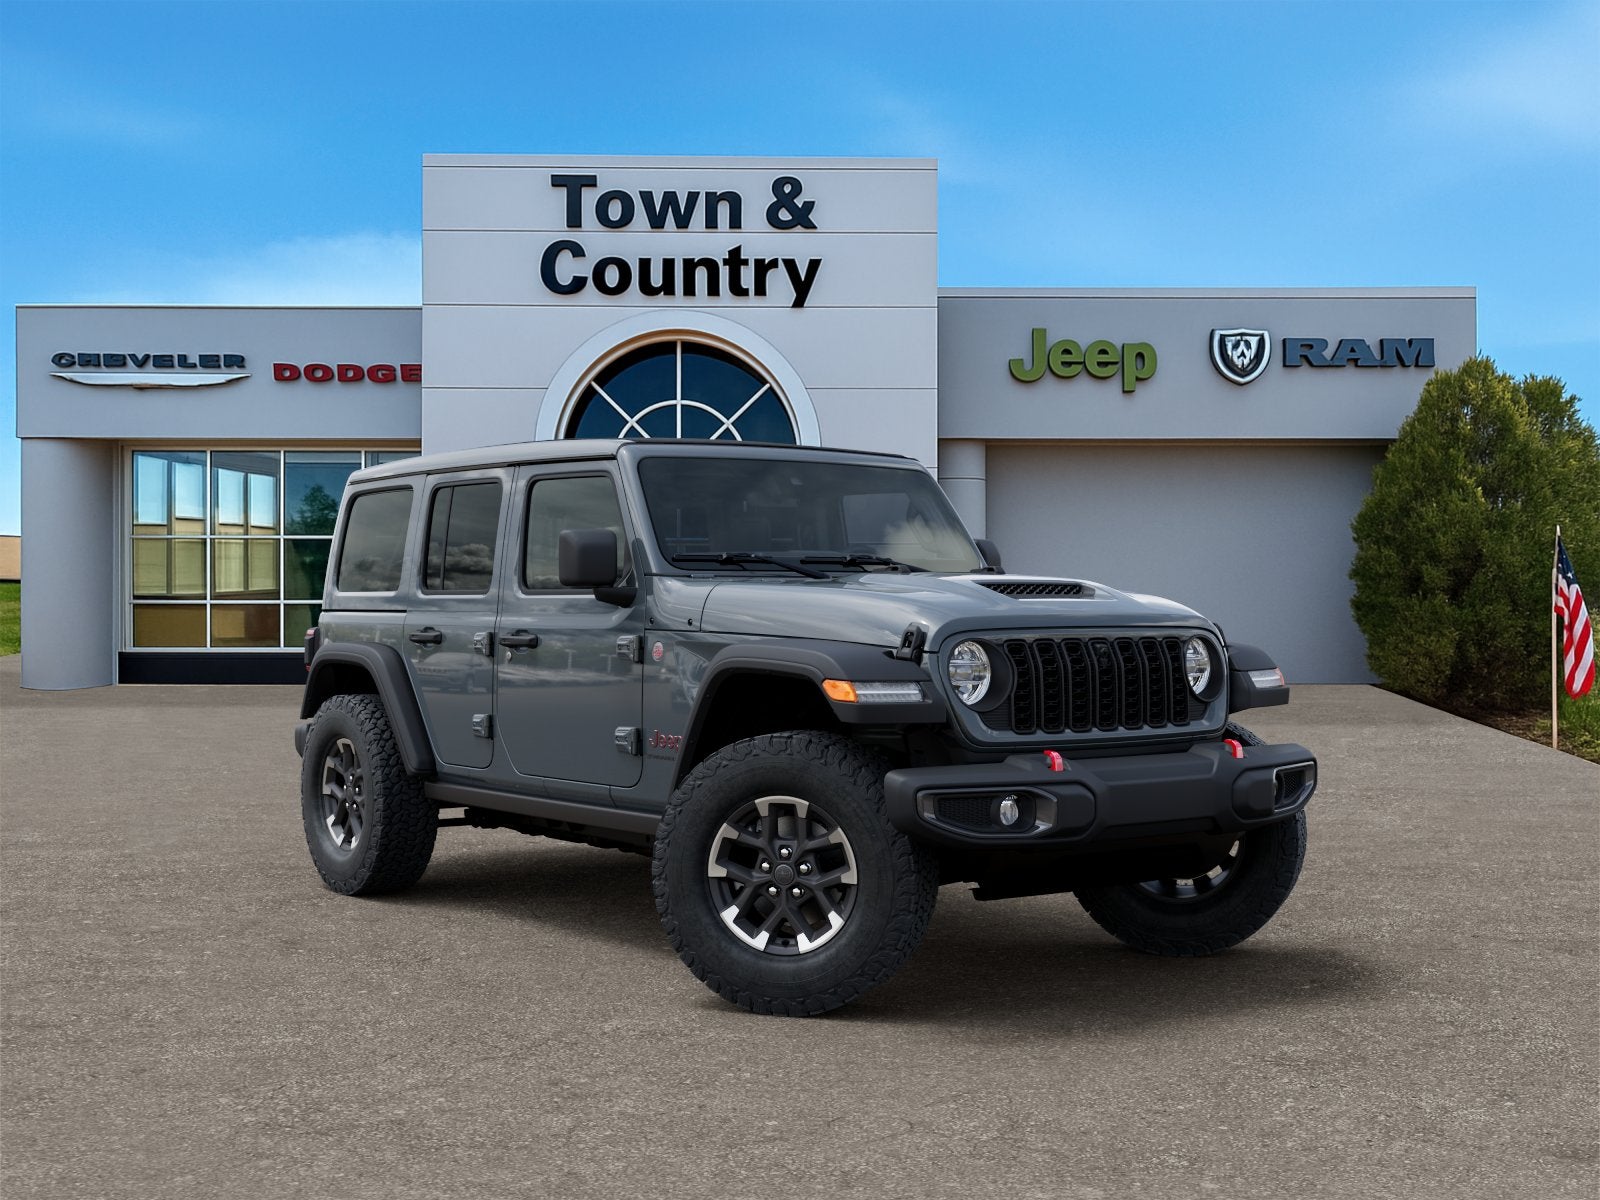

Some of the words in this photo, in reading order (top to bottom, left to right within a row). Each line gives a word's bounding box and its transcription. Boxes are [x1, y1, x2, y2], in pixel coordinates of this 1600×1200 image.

[550, 173, 743, 230] Town
[765, 175, 818, 230] &
[539, 239, 823, 308] Country
[272, 362, 422, 383] DODGE
[1008, 327, 1158, 393] Jeep
[1282, 337, 1435, 368] RAM
